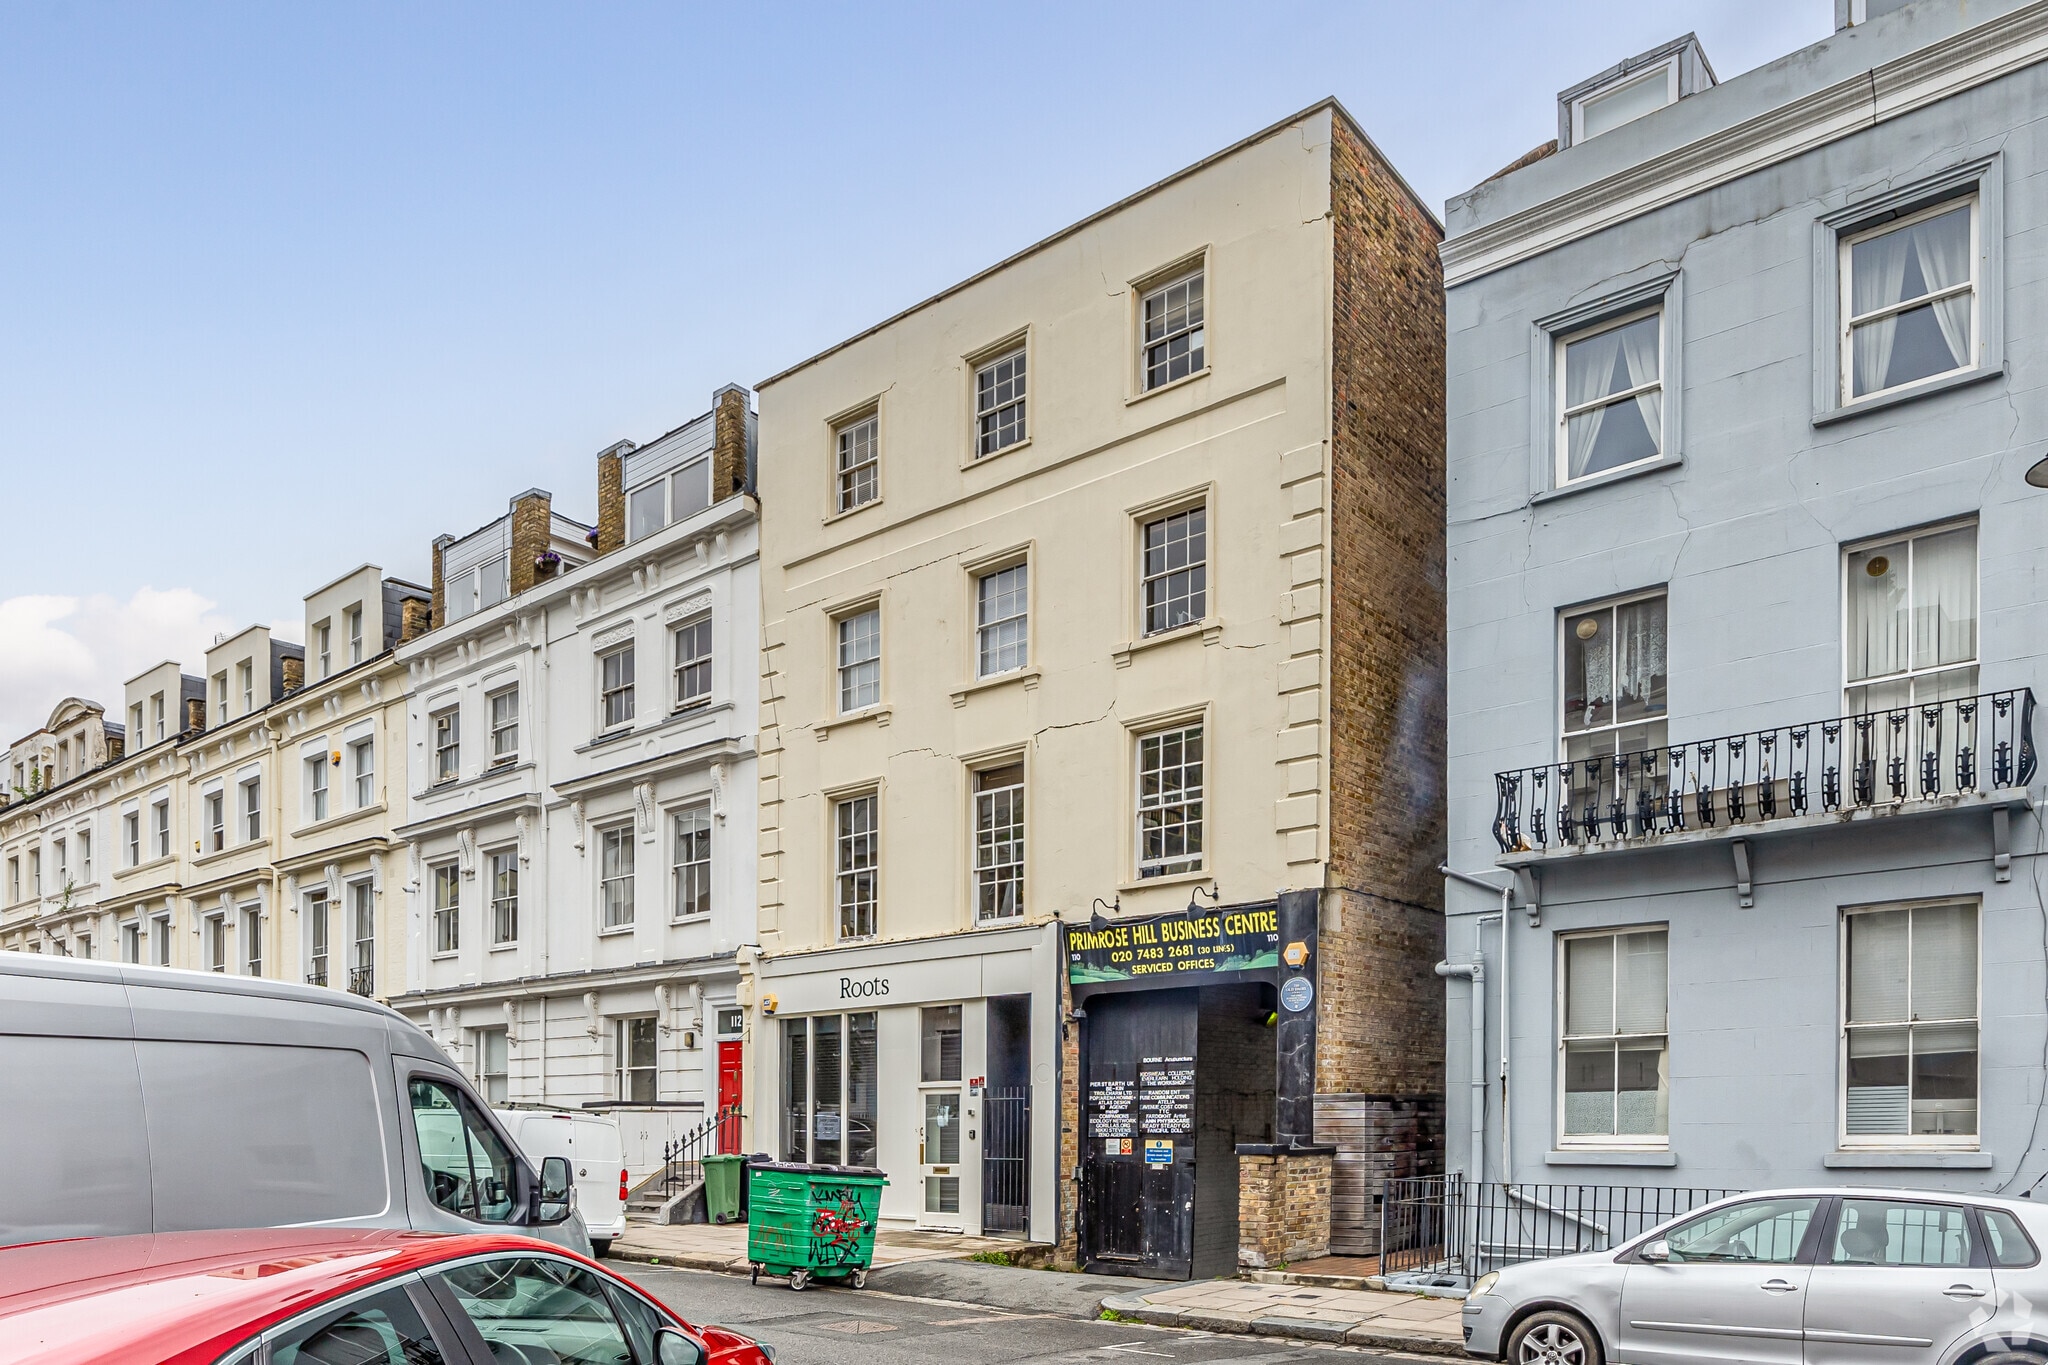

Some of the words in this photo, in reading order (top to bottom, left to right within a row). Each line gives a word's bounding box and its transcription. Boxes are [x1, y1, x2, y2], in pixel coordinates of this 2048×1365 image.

[1069, 927, 1129, 951] PRIMROSE
[1132, 924, 1158, 945] HILL
[1161, 916, 1220, 942] BUSINESS
[1225, 910, 1278, 936] CENTRE
[1266, 933, 1279, 942] 110
[1071, 953, 1081, 961] 110
[1111, 950, 1133, 963] 020
[1136, 947, 1164, 961] 7483
[1168, 944, 1194, 957] 2681
[1131, 962, 1173, 975] SERVICED
[1177, 958, 1215, 971] OFFICES
[839, 976, 890, 999] Roots
[731, 1015, 742, 1027] 112
